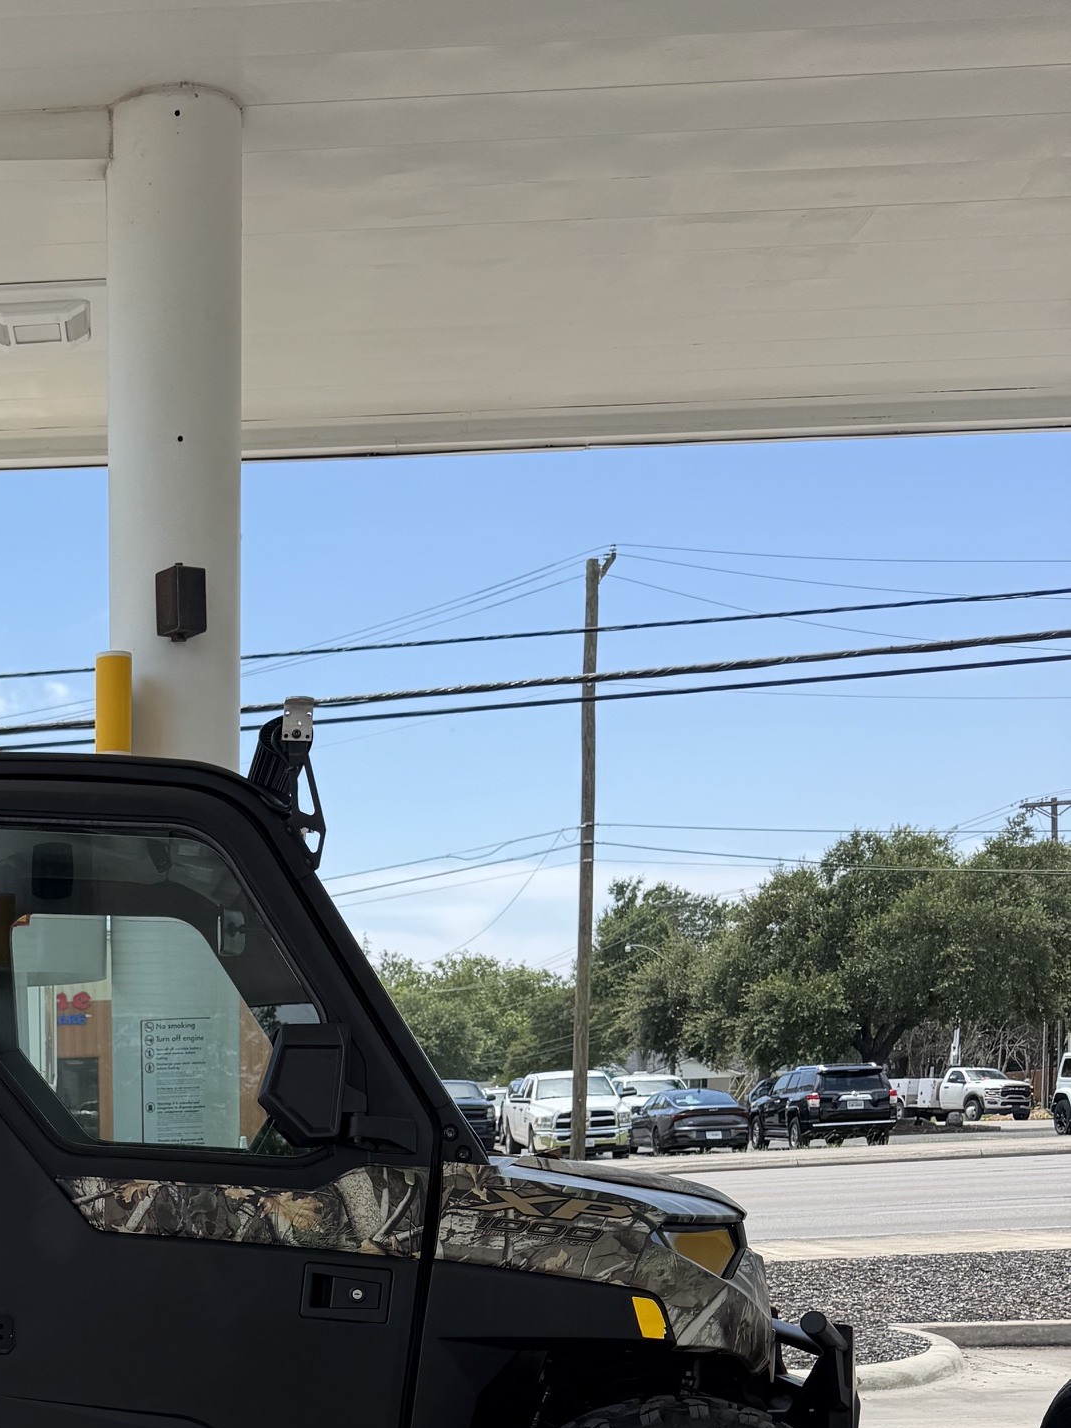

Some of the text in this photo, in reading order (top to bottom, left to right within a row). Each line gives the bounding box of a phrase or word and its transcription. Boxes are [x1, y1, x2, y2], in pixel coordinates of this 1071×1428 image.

[168, 1021, 196, 1031] smoking
[156, 1034, 205, 1043] Turn off engine
[464, 1189, 634, 1221] XP
[475, 1215, 605, 1243] 1000
